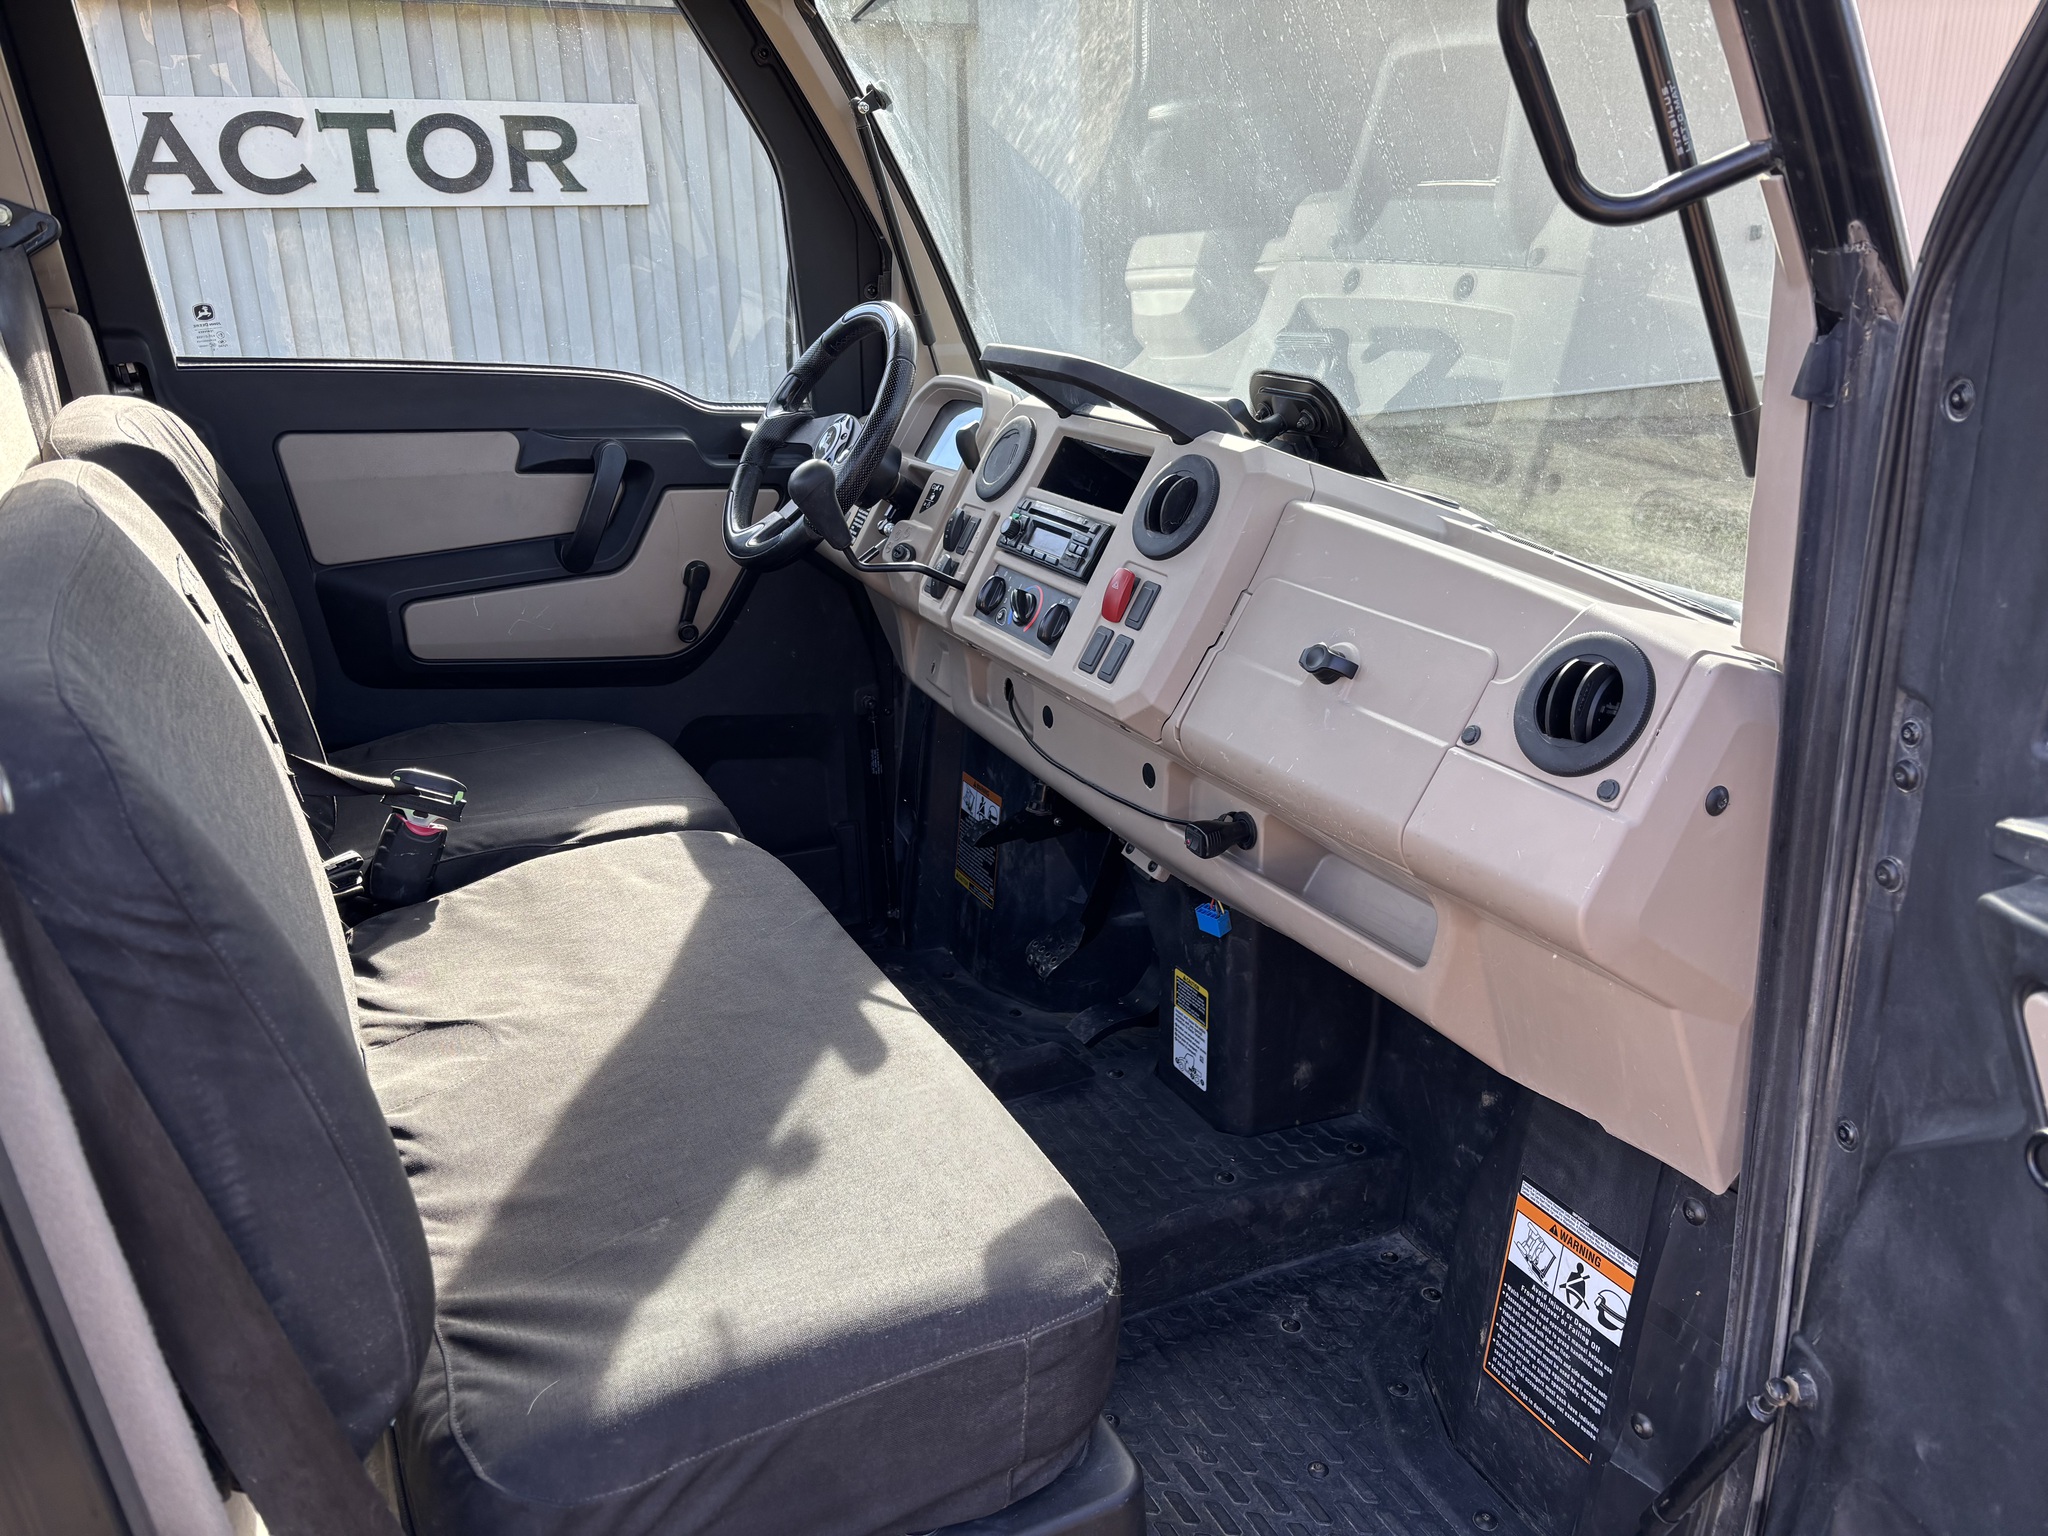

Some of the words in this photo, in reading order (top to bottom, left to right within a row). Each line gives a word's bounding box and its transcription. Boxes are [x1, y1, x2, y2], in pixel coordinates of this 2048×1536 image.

[128, 109, 588, 195] ACTOR
[1661, 87, 1684, 155] STABILUS
[1558, 1229, 1601, 1268] WARNING
[1503, 1300, 1512, 1311] seat
[1520, 1315, 1526, 1323] on
[1526, 1319, 1534, 1330] and
[1534, 1326, 1544, 1338] both
[1544, 1334, 1553, 1346] feet
[1553, 1342, 1559, 1352] on
[1504, 1291, 1525, 1314] Passenger
[1525, 1309, 1536, 1322] must
[1535, 1317, 1541, 1327] be
[1542, 1322, 1551, 1335] able
[1551, 1331, 1557, 1339] to
[1556, 1336, 1569, 1351] grasp
[1593, 1364, 1604, 1377] with
[1519, 1294, 1531, 1308] video
[1530, 1304, 1539, 1314] and
[1538, 1310, 1549, 1323] read
[1571, 1336, 1588, 1355] manual
[1587, 1350, 1603, 1367] before
[1520, 1283, 1535, 1301] From
[1535, 1296, 1560, 1321] Rollover
[1560, 1317, 1567, 1327] or
[1567, 1322, 1589, 1346] Falling
[1590, 1340, 1600, 1354] Off
[1531, 1283, 1547, 1301] Avoid
[1547, 1296, 1565, 1316] Injury
[1565, 1312, 1572, 1321] or
[1573, 1316, 1592, 1337] Death
[1495, 1339, 1507, 1354] Driver
[1507, 1350, 1515, 1361] and
[1521, 1363, 1544, 1388] passengers
[1544, 1383, 1556, 1397] must
[1555, 1392, 1567, 1406] each
[1566, 1402, 1578, 1416] have
[1515, 1319, 1519, 1327] is
[1562, 1358, 1571, 1371] and
[1570, 1365, 1580, 1378] side
[1552, 1361, 1559, 1370] be
[1559, 1366, 1570, 1380] used
[1569, 1375, 1576, 1386] by
[1490, 1362, 1501, 1376] Keep
[1511, 1381, 1519, 1392] and
[1518, 1388, 1528, 1402] legs
[1532, 1401, 1546, 1418] during
[1493, 1347, 1502, 1359] seat
[1545, 1393, 1556, 1407] must
[1556, 1403, 1564, 1414] not
[1564, 1409, 1580, 1428] exceed
